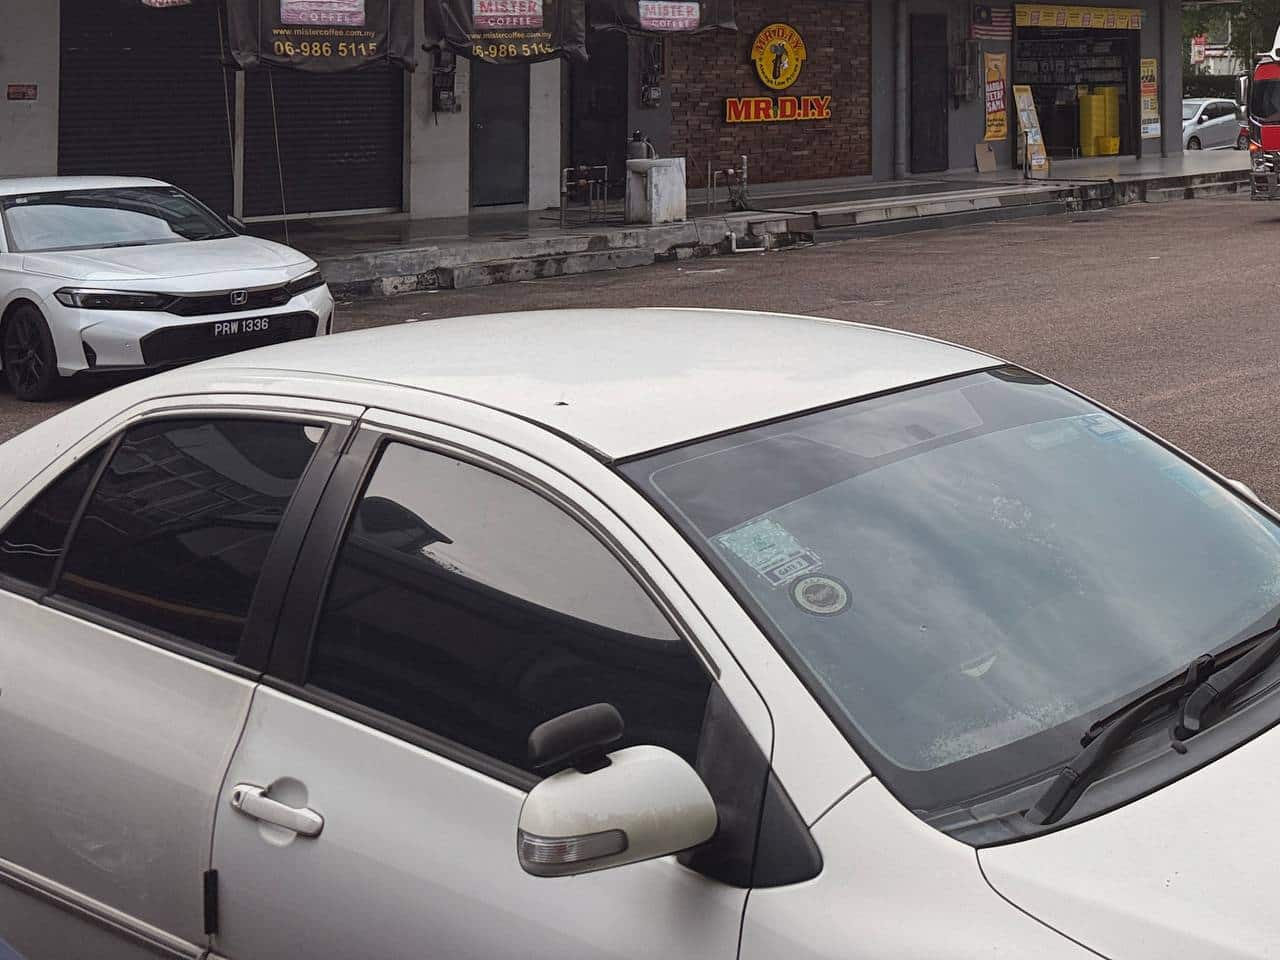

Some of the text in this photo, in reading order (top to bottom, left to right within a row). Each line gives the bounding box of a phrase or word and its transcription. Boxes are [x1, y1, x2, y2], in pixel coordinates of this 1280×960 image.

[480, 0, 537, 13] MISTER
[644, 4, 694, 17] MISTER
[488, 17, 531, 26] COFFEE
[272, 27, 375, 38] www.mistercoffee.com.my
[274, 41, 377, 56] 06-986 5115
[214, 318, 269, 337] PRW 1336
